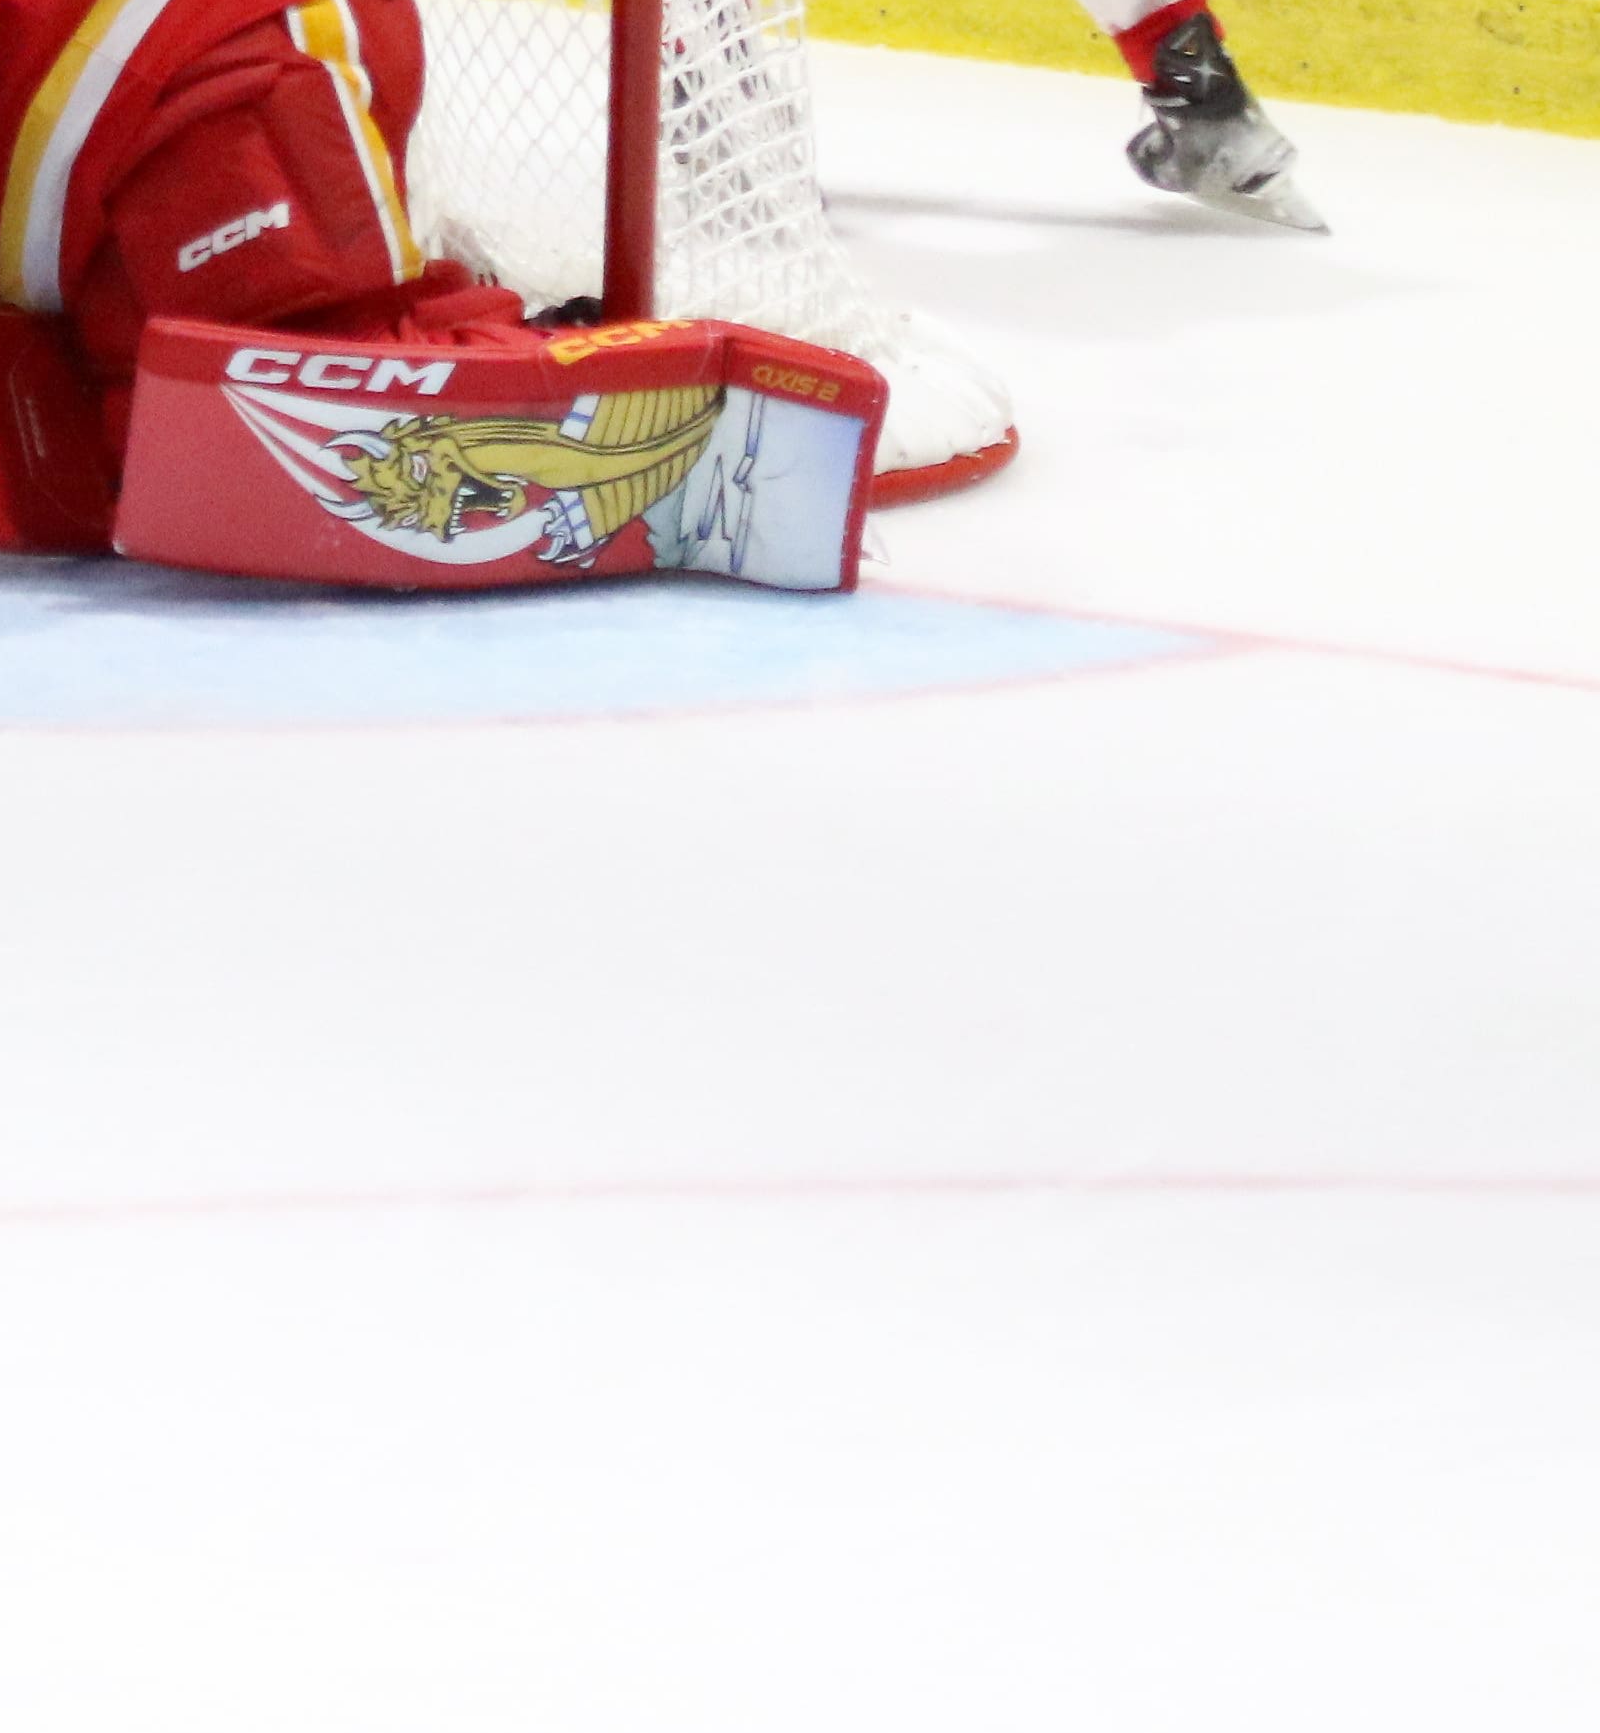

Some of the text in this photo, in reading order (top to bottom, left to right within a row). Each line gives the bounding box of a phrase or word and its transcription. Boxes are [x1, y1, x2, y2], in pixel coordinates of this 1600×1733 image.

[178, 202, 292, 272] CCM
[546, 318, 694, 366] CCM
[224, 348, 457, 397] CCM
